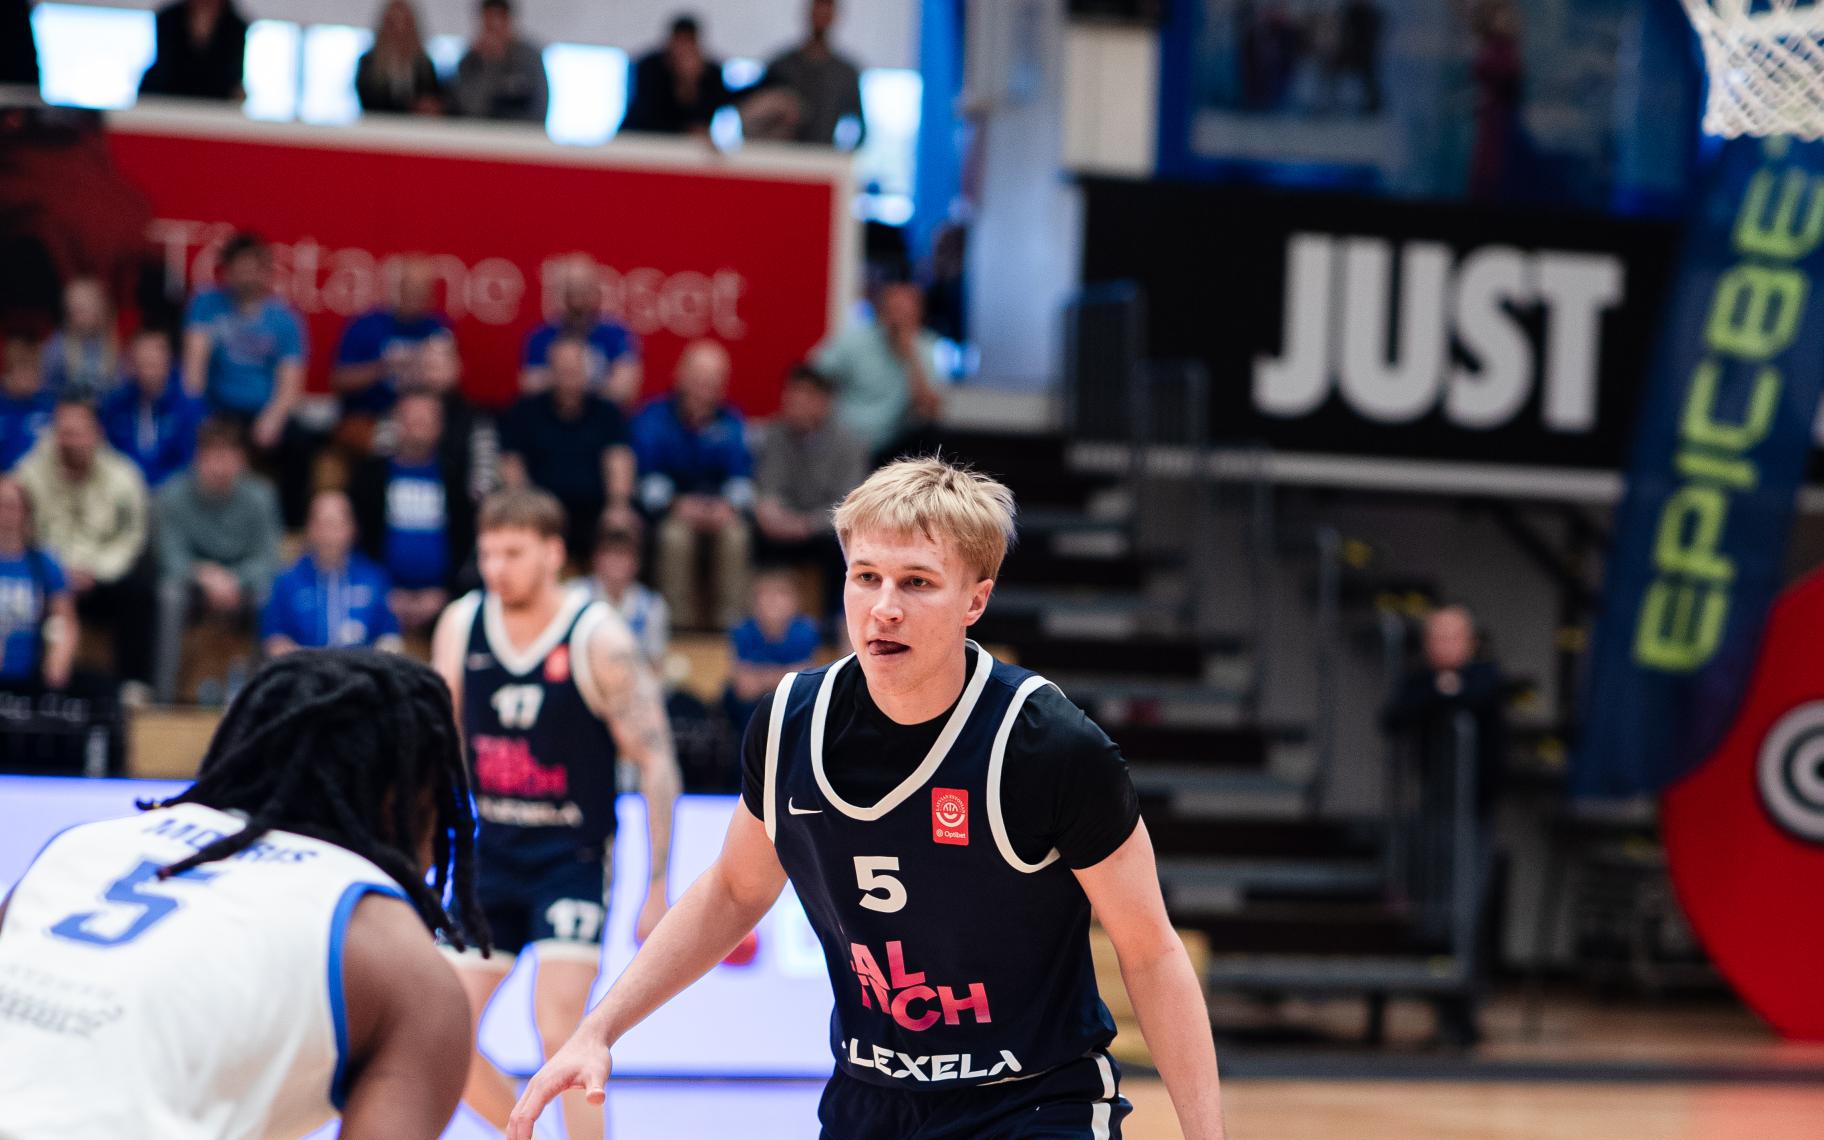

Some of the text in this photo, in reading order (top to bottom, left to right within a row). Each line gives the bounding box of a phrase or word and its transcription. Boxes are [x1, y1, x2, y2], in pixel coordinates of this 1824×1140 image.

[1251, 231, 1625, 433] JUST
[1633, 130, 1824, 671] EPICBE
[491, 684, 545, 730] 17
[50, 857, 226, 946] 5
[854, 855, 908, 914] 5
[546, 898, 605, 939] 17
[842, 1037, 1023, 1082] LEXELA
